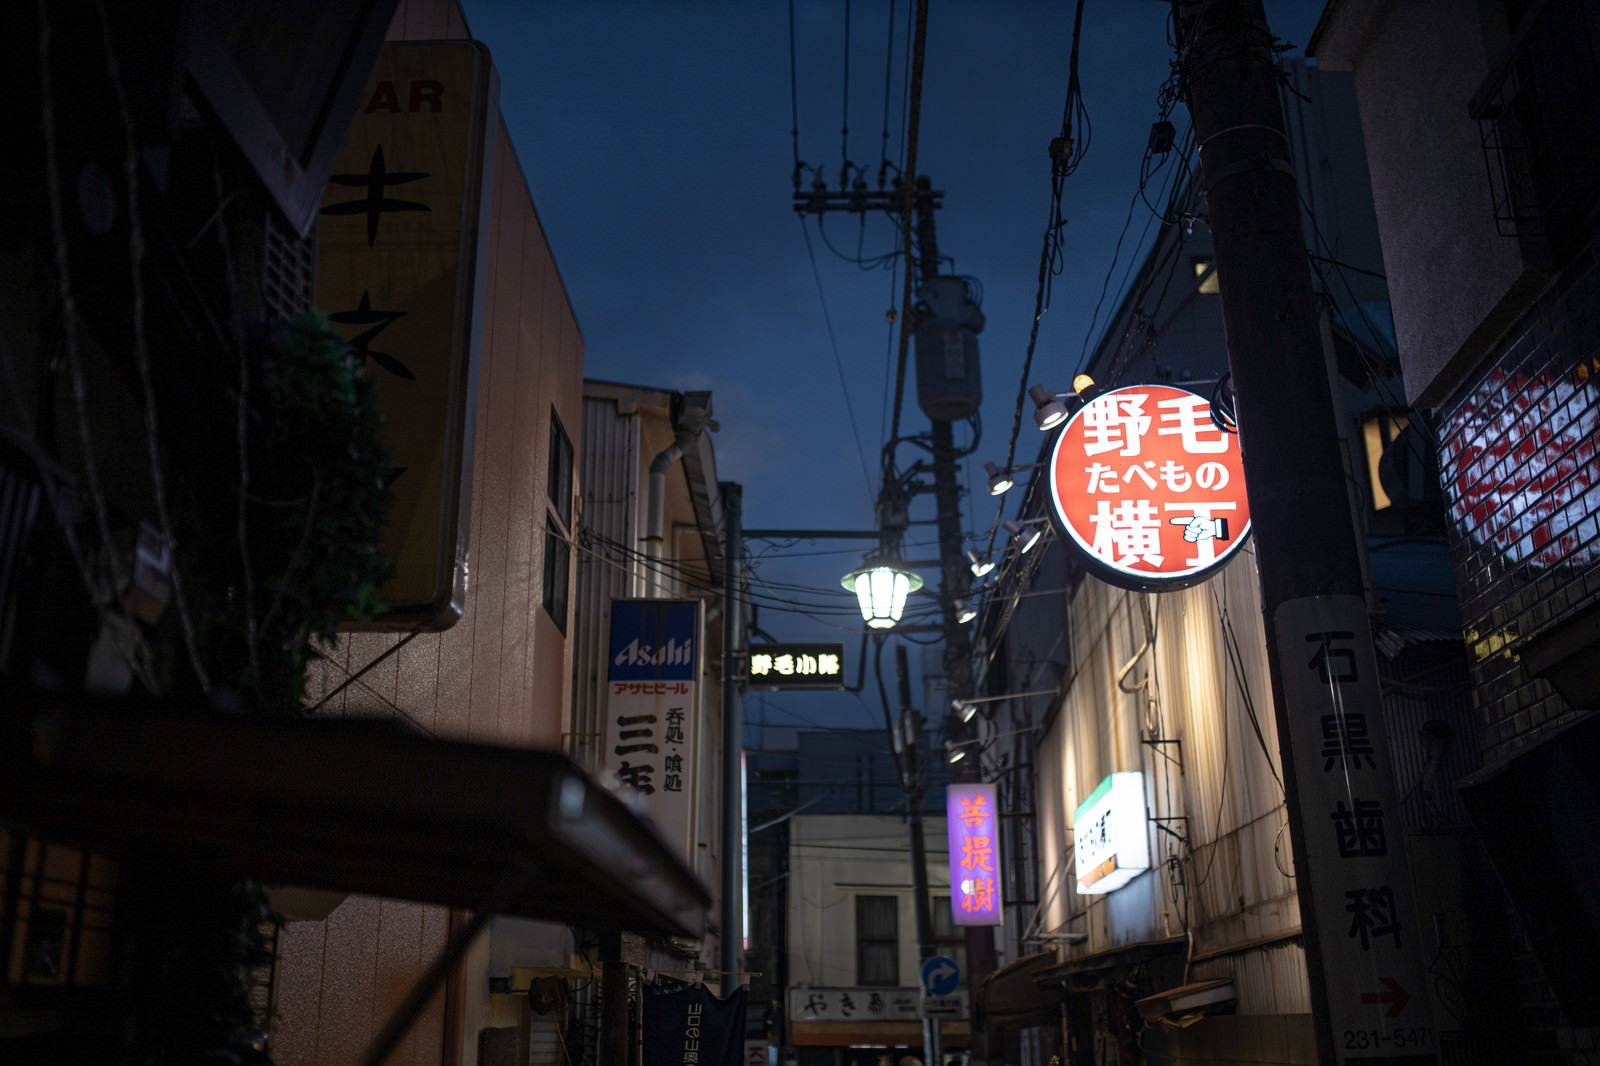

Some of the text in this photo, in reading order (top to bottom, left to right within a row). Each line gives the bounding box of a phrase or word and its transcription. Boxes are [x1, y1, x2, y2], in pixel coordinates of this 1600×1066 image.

[365, 80, 445, 114] AR
[319, 144, 432, 488] キネ
[1083, 394, 1229, 456] 野毛
[1085, 461, 1230, 494] たべもの
[1089, 500, 1237, 568] 横丁
[614, 637, 692, 667] Asahi
[614, 683, 688, 695] アサヒビール
[1305, 631, 1402, 951] 石黒歯科
[957, 794, 995, 913] 菩提樹
